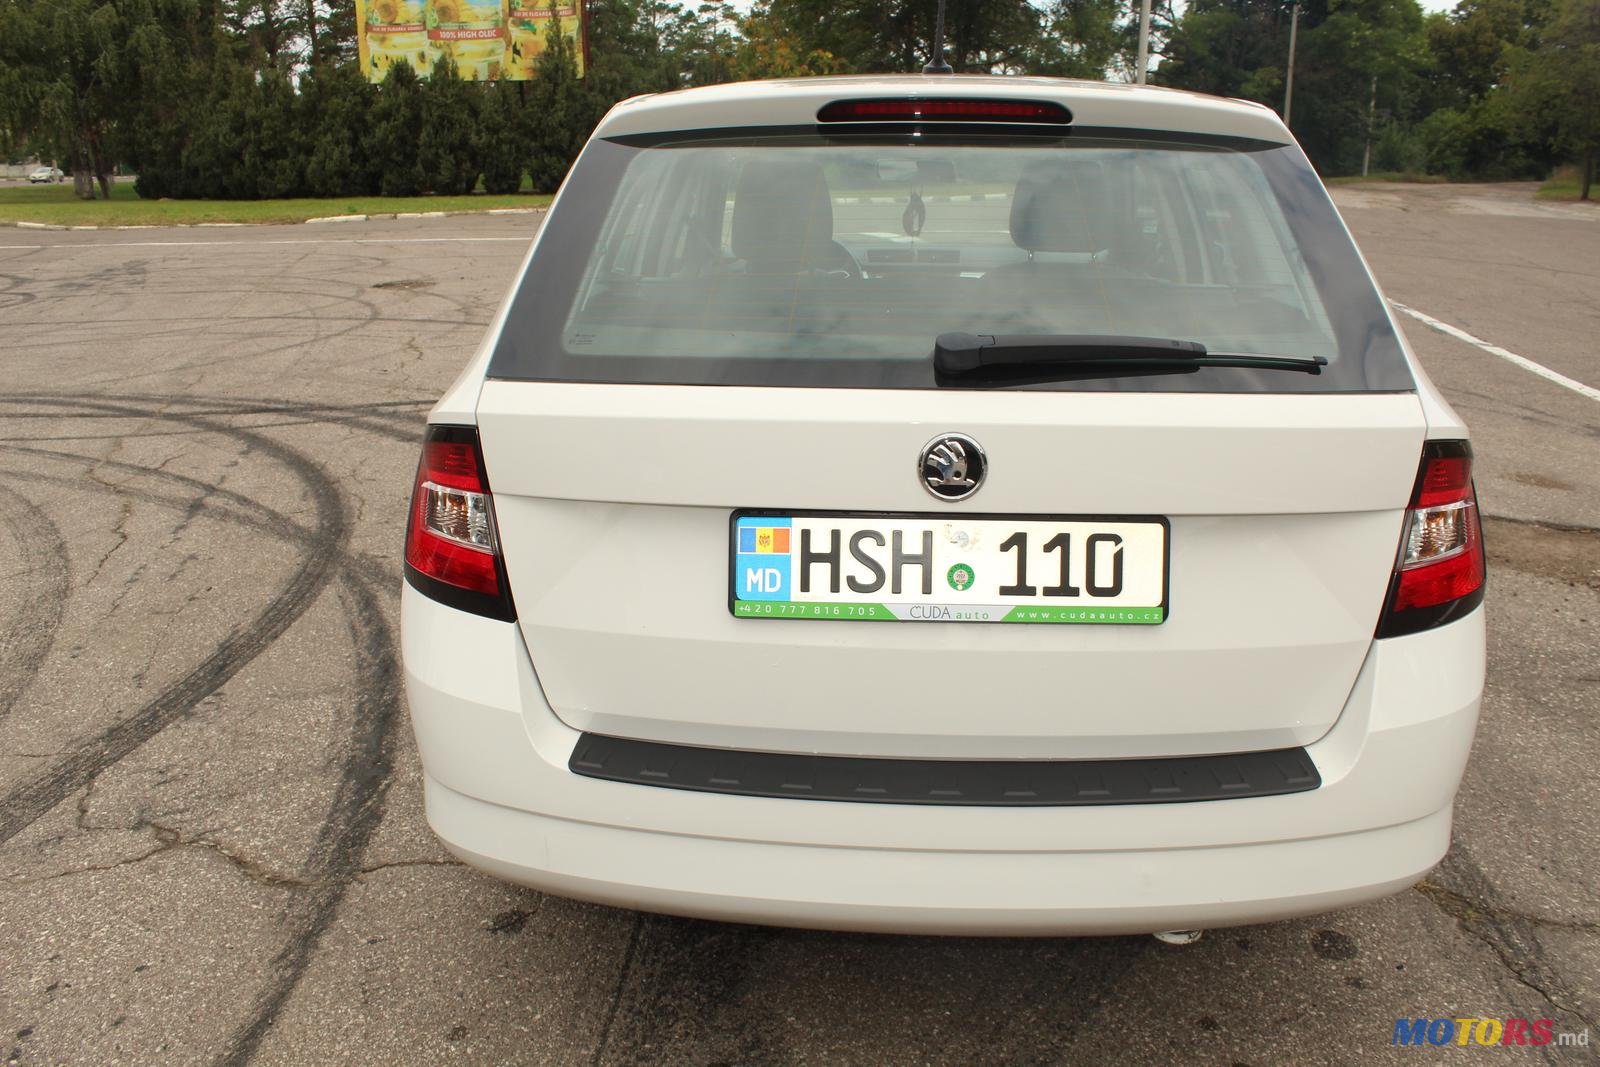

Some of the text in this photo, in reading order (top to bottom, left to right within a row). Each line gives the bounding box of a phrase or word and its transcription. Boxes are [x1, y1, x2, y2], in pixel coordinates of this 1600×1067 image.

[440, 30, 456, 39] 100%
[800, 528, 933, 594] HSH
[999, 531, 1123, 597] 110
[746, 568, 782, 593] MD
[739, 604, 876, 616] +420 777 816 705
[955, 610, 989, 620] auto
[1016, 611, 1160, 620] www.cudaauto.cz
